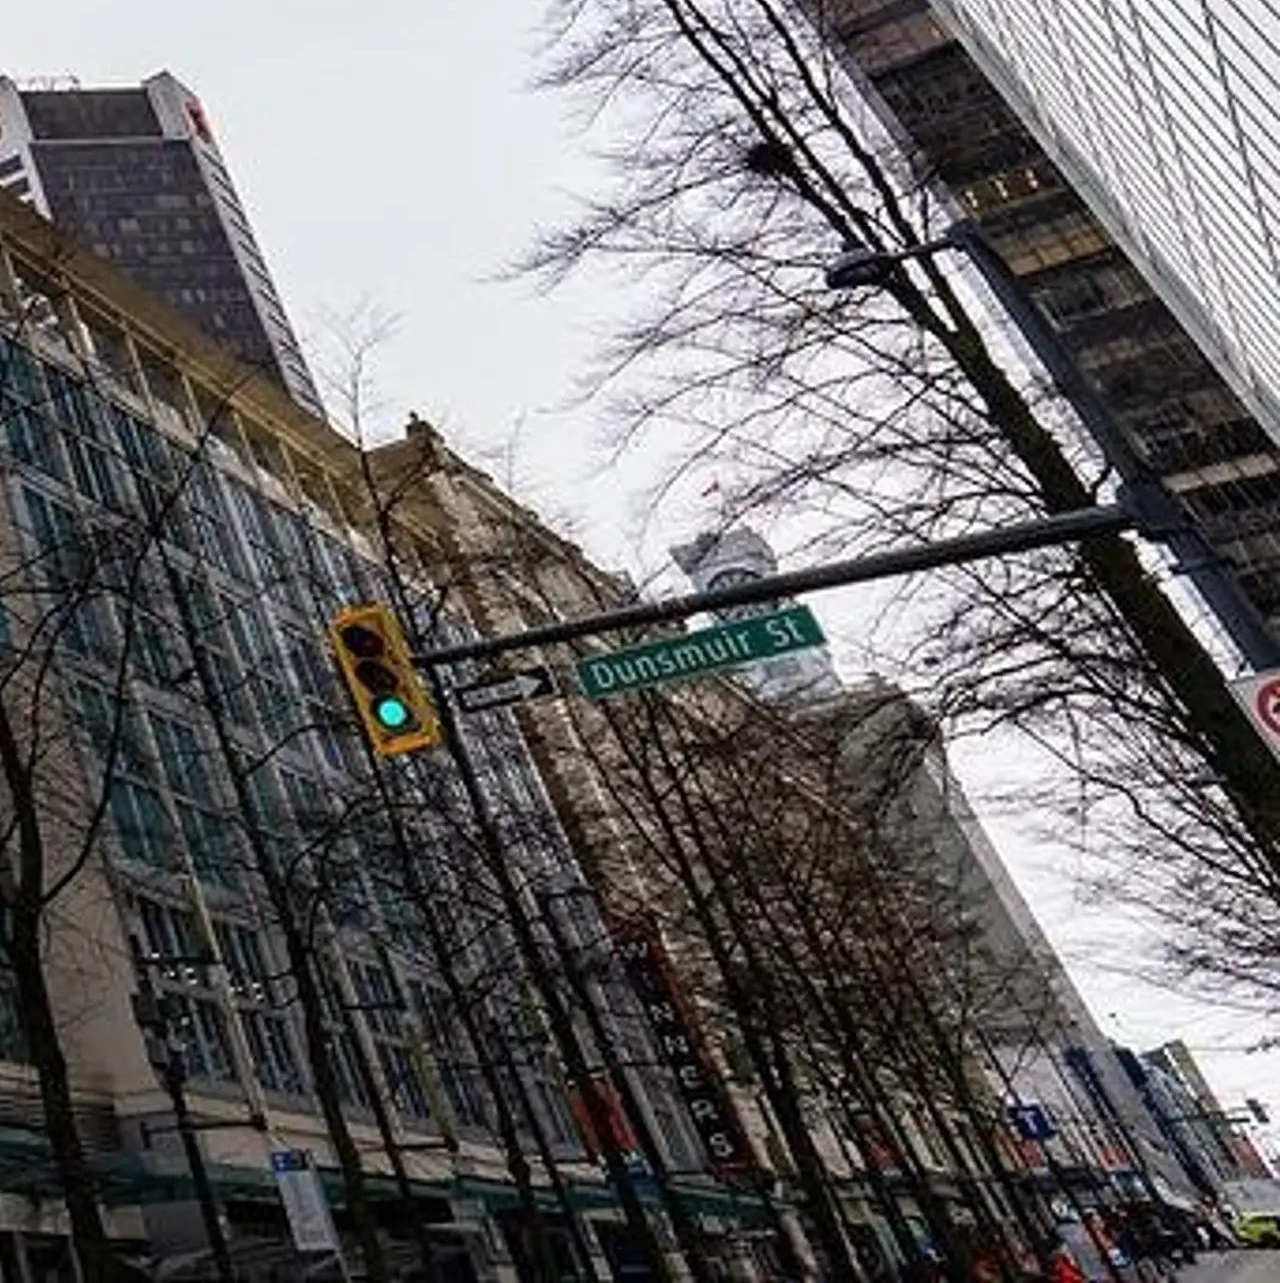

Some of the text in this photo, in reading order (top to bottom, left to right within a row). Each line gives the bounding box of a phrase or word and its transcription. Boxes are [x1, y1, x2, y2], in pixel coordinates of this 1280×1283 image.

[590, 609, 807, 690] Dunsmuir St
[608, 938, 736, 1159] WNNERS
